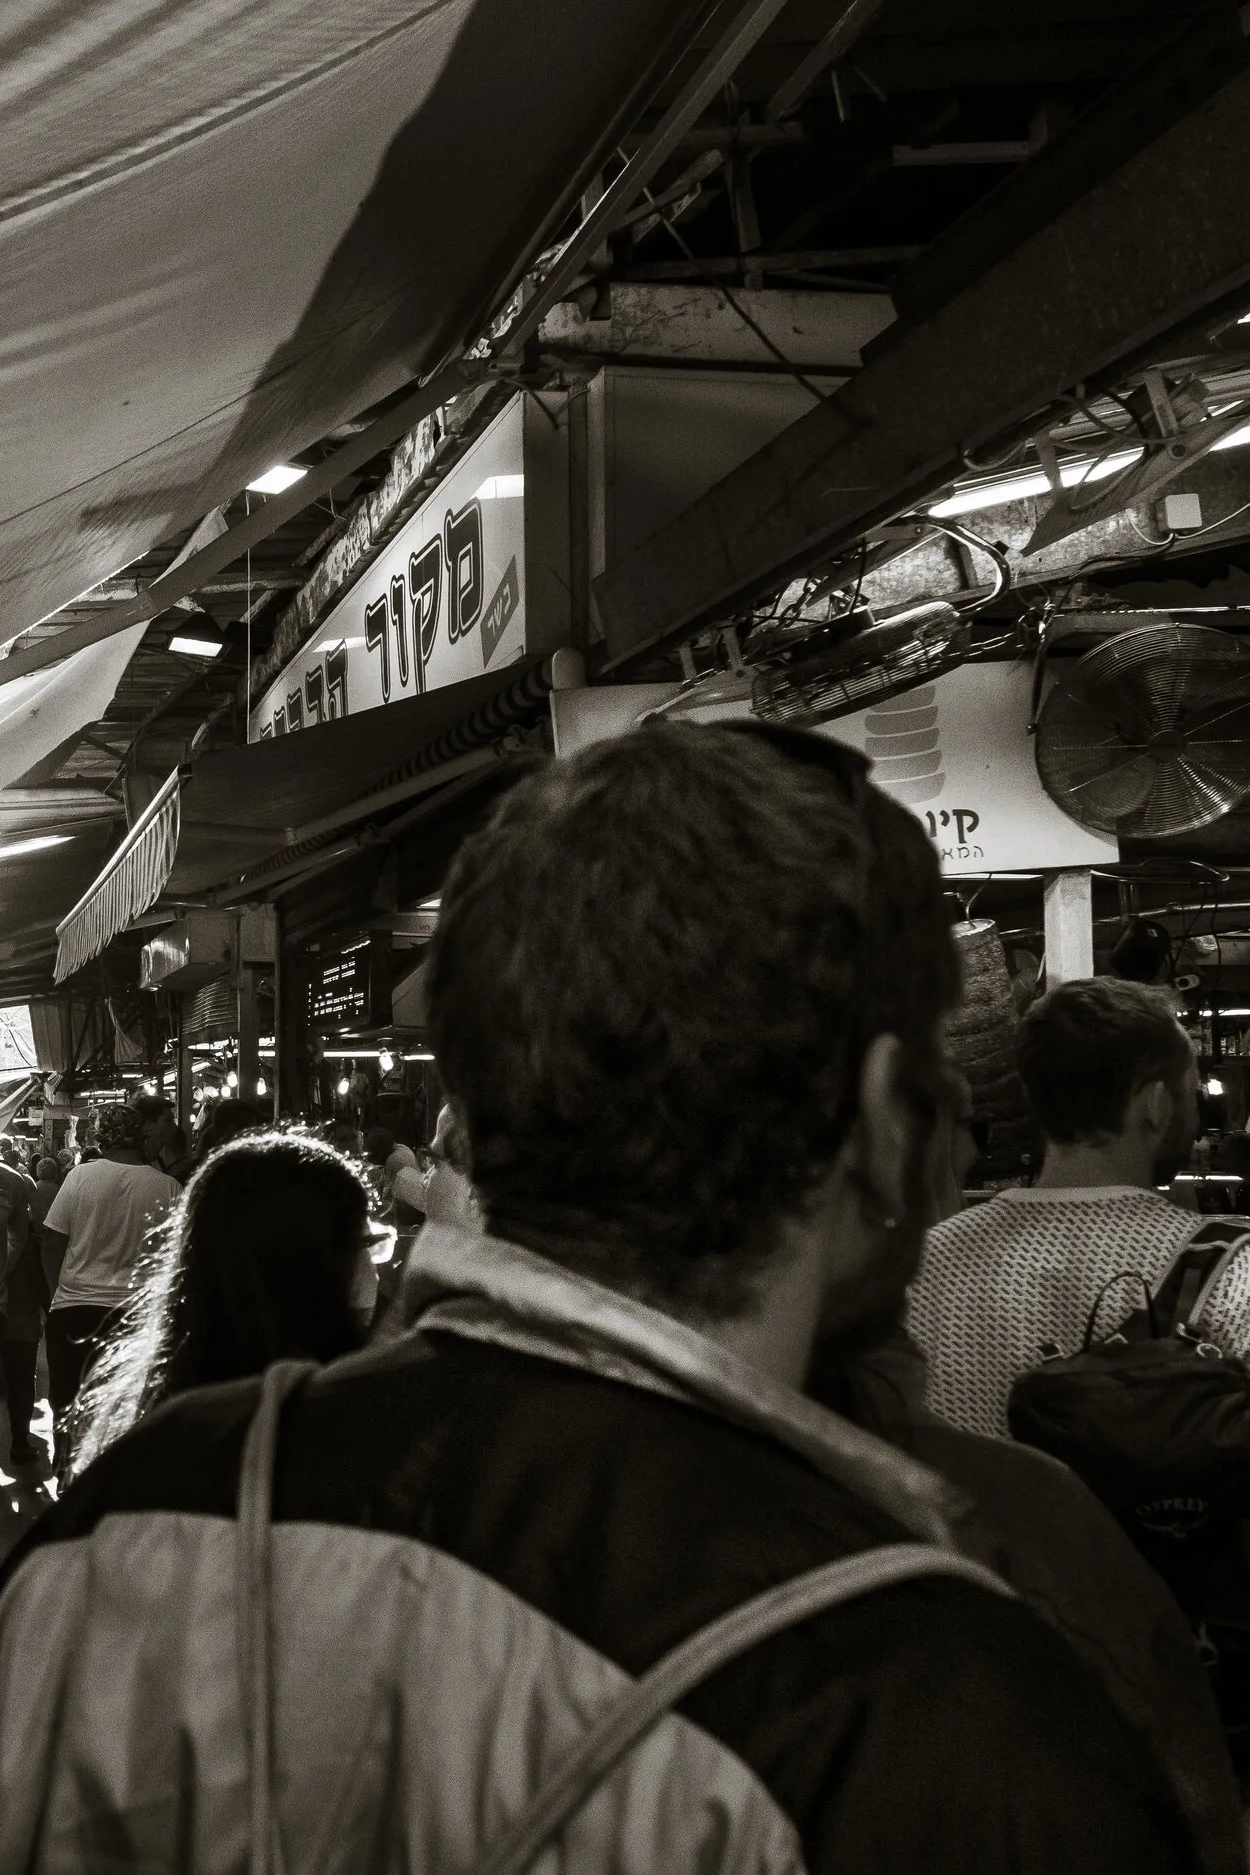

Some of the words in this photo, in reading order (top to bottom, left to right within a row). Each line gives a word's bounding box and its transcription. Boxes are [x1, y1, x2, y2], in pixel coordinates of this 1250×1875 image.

[365, 498, 483, 703] מקור
[487, 582, 511, 636] כשר
[925, 808, 980, 844] קיו
[941, 845, 985, 861] המא
